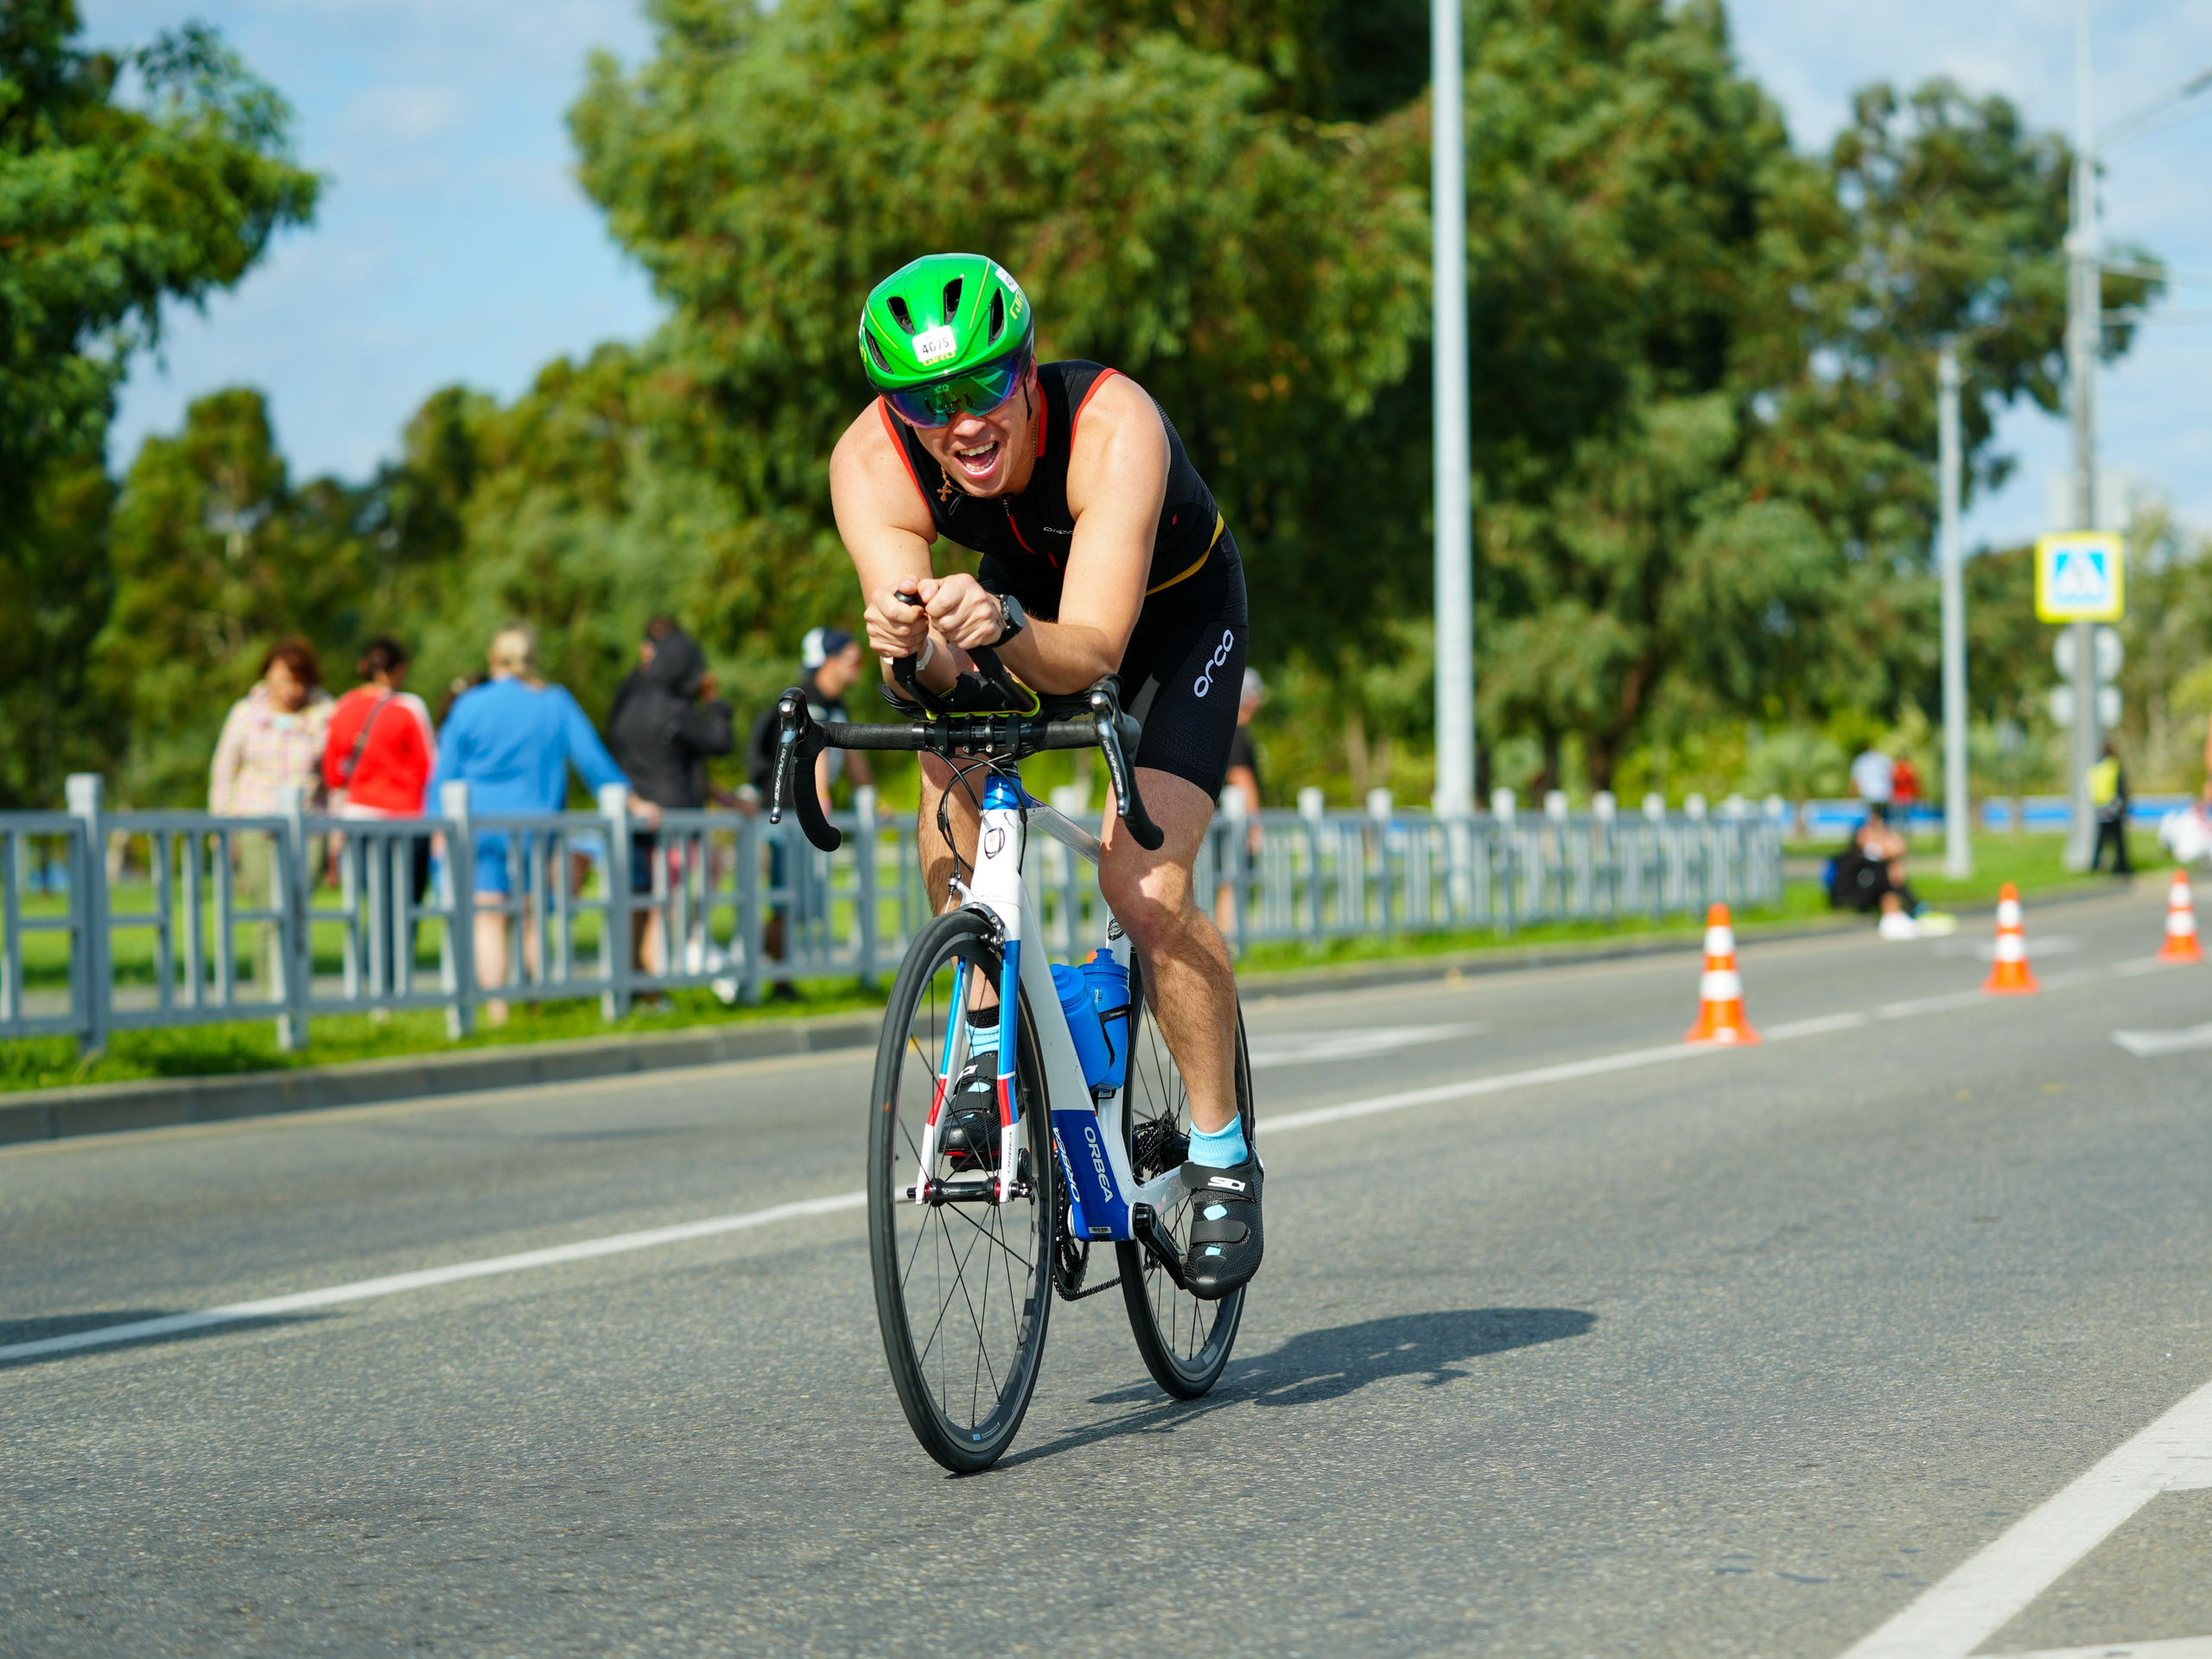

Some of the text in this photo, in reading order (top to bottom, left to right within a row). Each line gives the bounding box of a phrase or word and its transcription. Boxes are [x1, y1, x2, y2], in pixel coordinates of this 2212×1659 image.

[1009, 288, 1025, 320] GIR
[922, 337, 950, 354] 4075
[1193, 629, 1234, 698] orca
[774, 747, 787, 802] DURA-ACE
[1103, 740, 1123, 793] DURA-ACE
[1052, 1127, 1080, 1203] ORBEA
[1084, 1126, 1114, 1204] ORBEA
